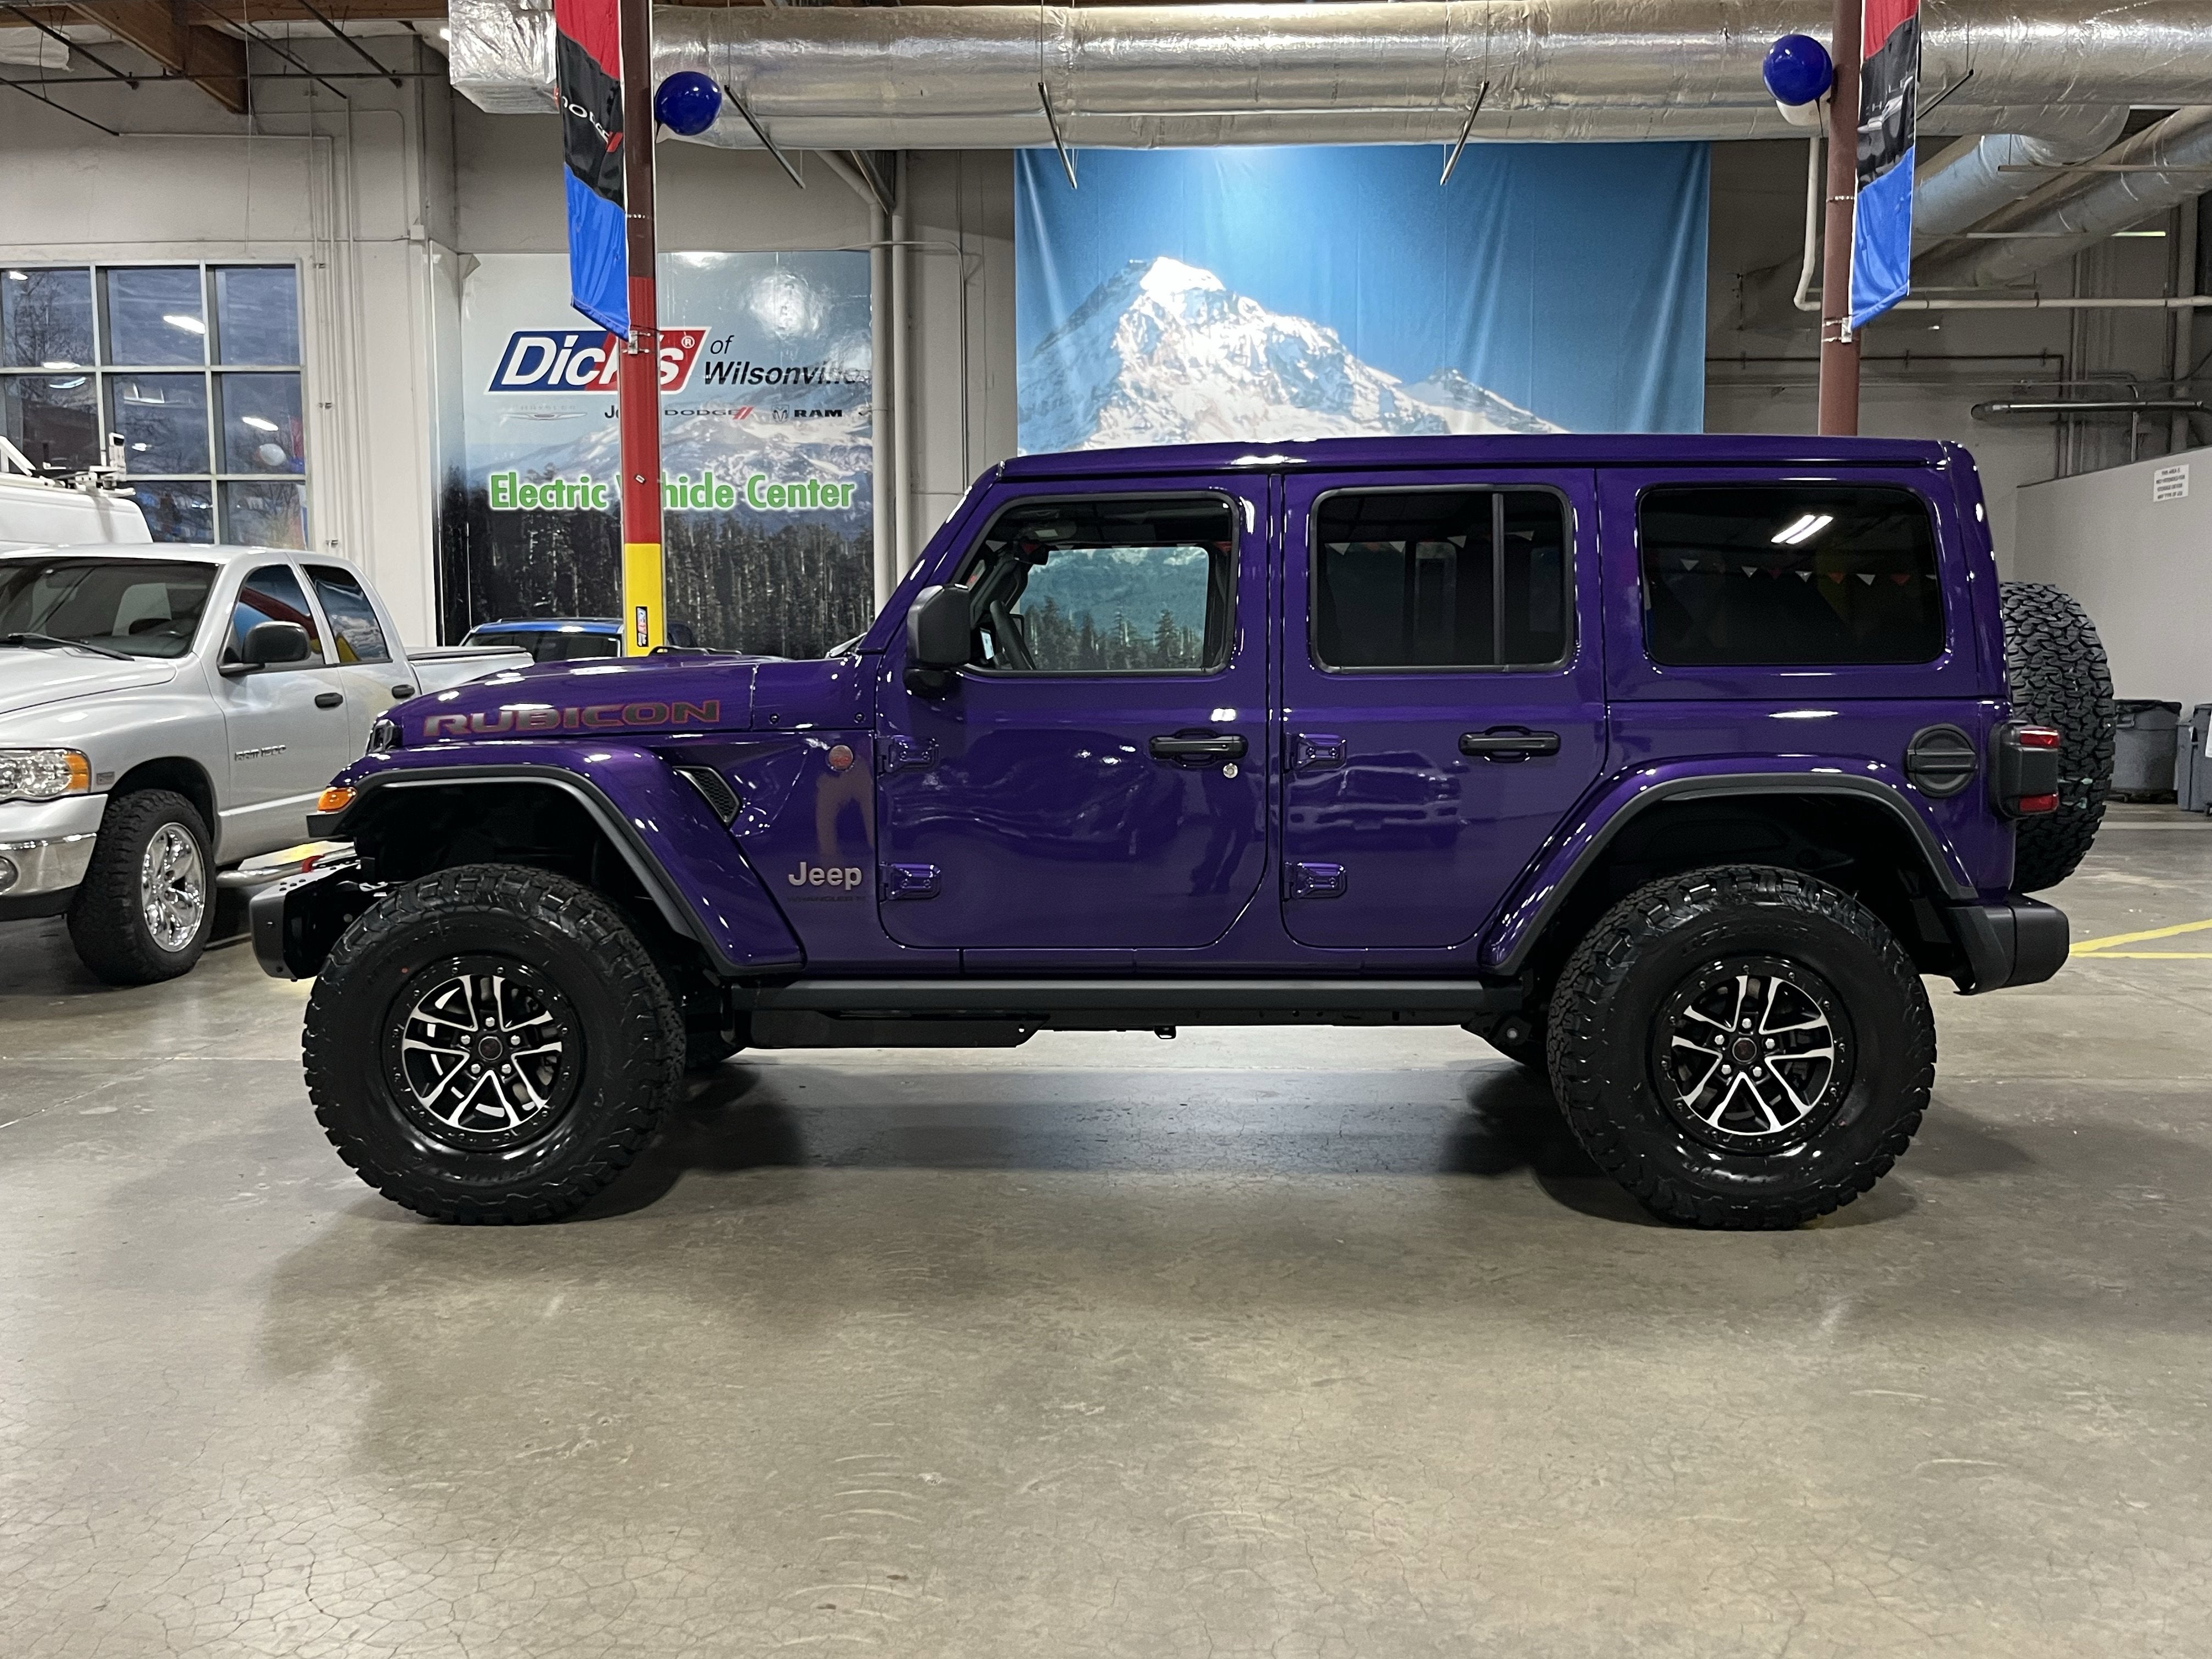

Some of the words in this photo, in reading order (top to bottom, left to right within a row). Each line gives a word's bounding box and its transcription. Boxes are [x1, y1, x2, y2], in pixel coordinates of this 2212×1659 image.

[501, 324, 684, 386] Dics
[710, 335, 735, 355] of
[794, 409, 843, 417] RAM
[491, 472, 607, 508] Electric
[617, 471, 734, 508] hicle
[747, 475, 855, 508] Center
[424, 700, 720, 736] RUBICON
[788, 862, 862, 890] Jeep
